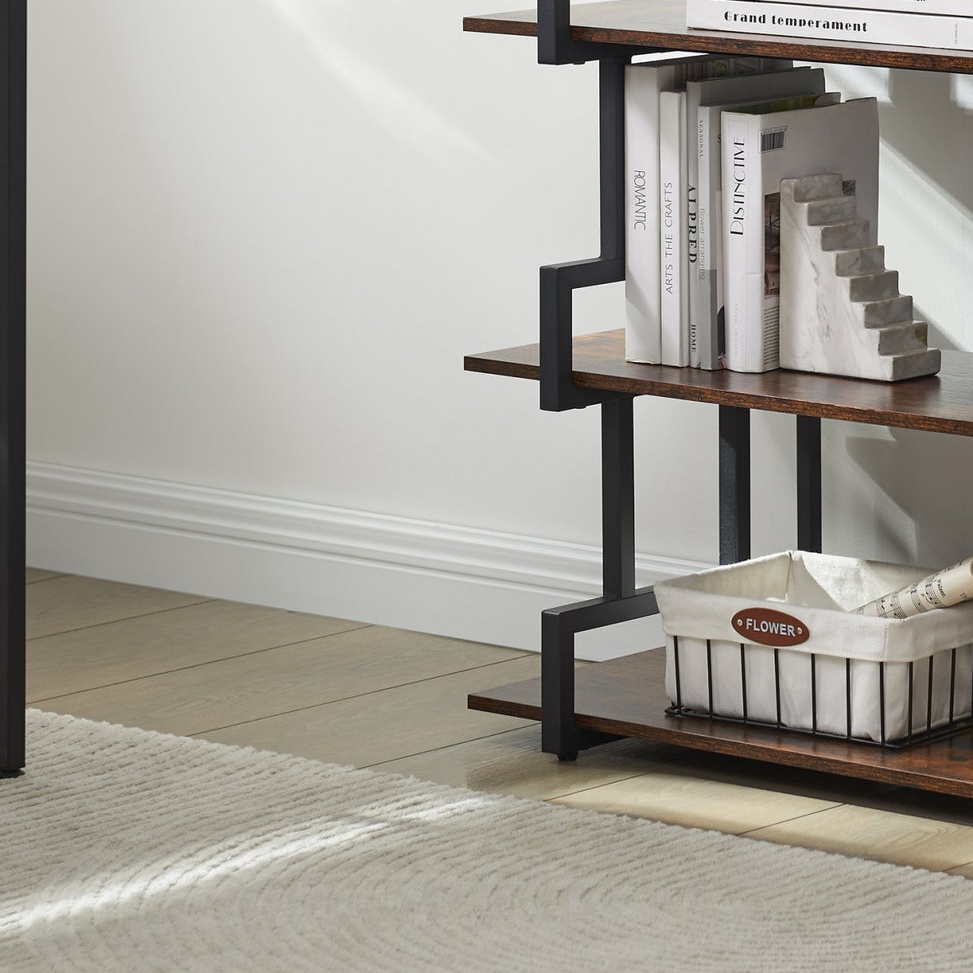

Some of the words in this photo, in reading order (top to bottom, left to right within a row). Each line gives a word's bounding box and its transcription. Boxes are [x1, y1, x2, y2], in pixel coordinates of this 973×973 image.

[724, 10, 766, 24] Grand
[771, 14, 868, 32] temperament
[633, 169, 646, 231] ROMANTIC
[729, 136, 746, 235] DISTINCTIVE
[664, 182, 673, 228] CRAFTS
[688, 184, 697, 263] ALPRED
[664, 233, 673, 258] THE
[665, 264, 673, 295] ARTS
[746, 618, 796, 637] FLOWER
